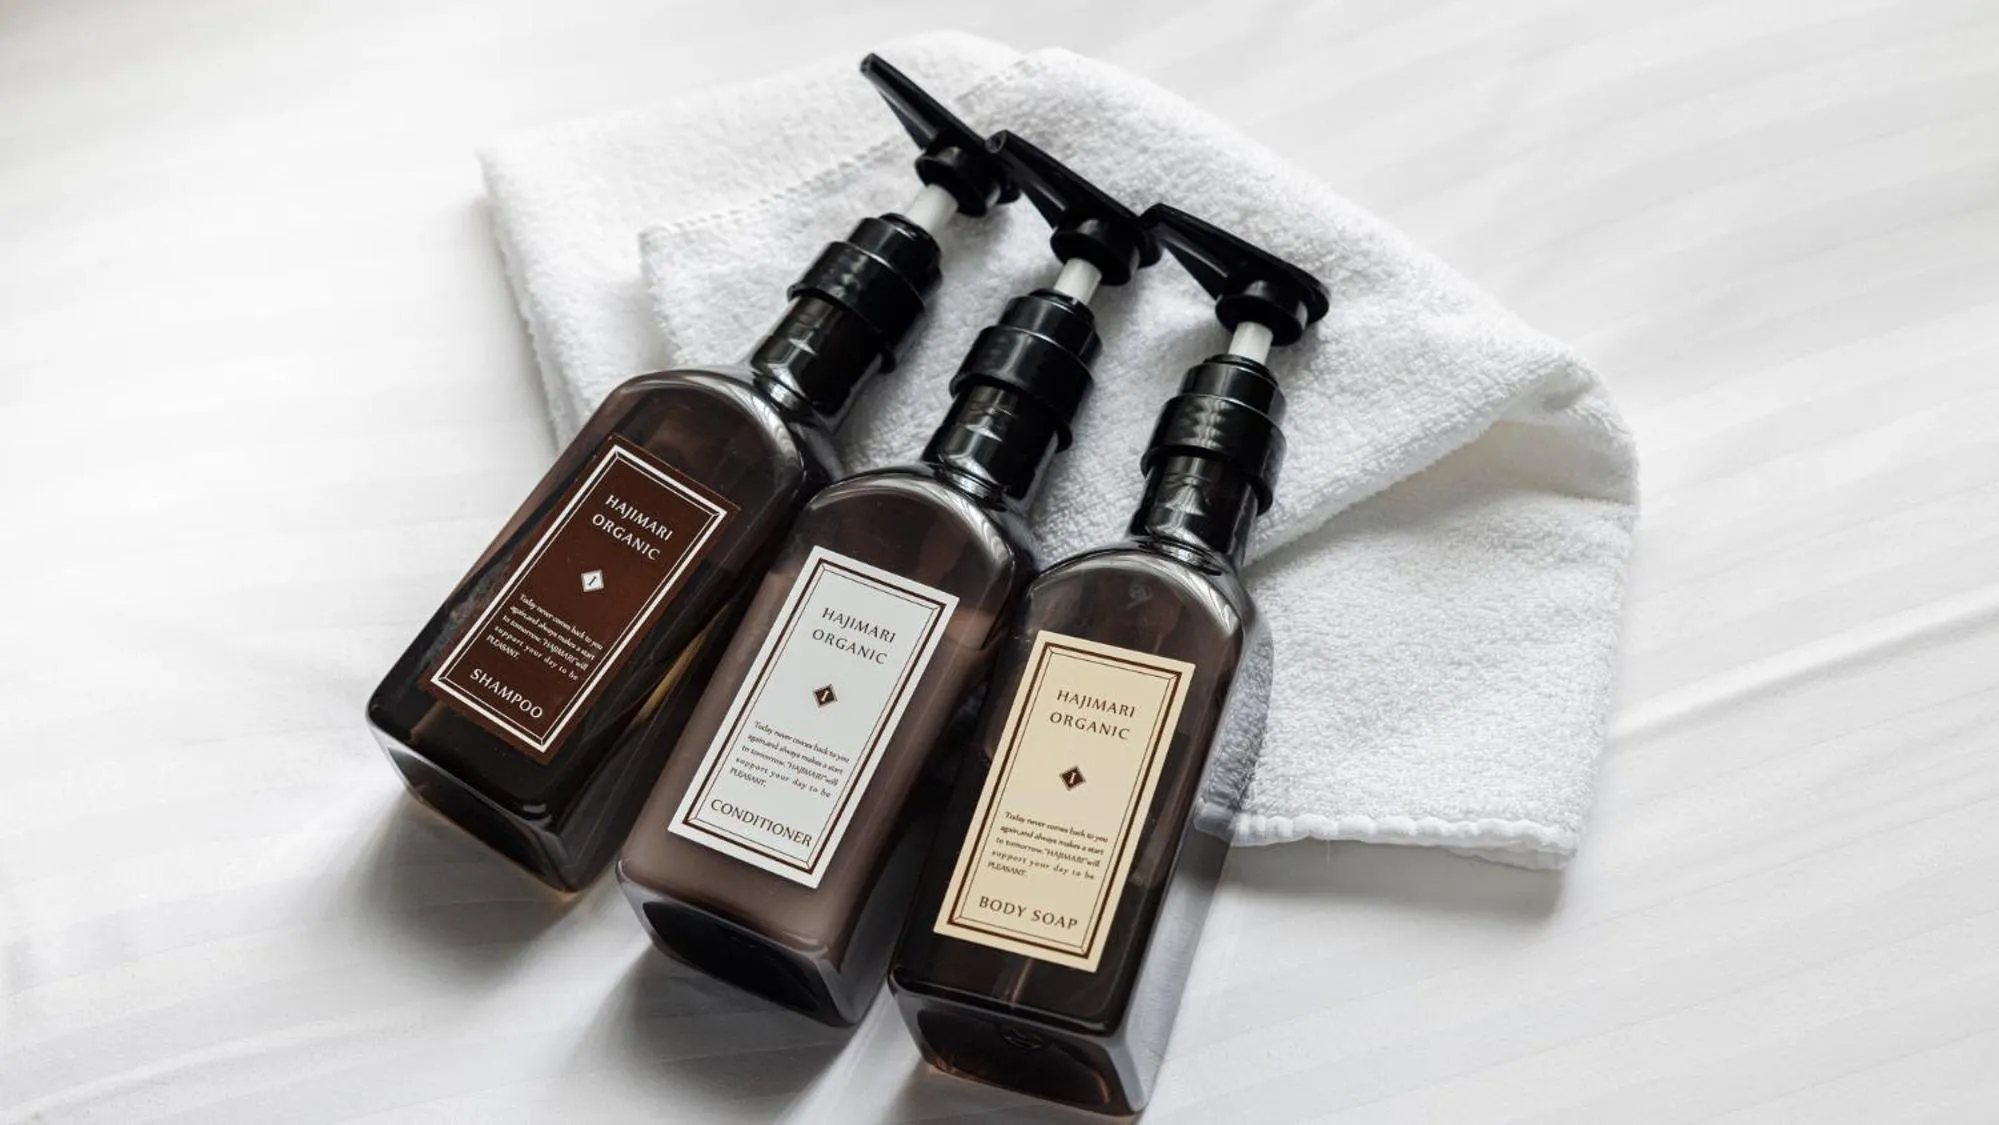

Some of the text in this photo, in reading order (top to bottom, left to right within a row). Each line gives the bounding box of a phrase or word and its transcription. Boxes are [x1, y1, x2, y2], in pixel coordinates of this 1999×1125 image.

[604, 494, 673, 541] HAJIMARI
[591, 513, 660, 560] ORGANIC
[519, 593, 536, 610] Today
[536, 606, 554, 619] never
[552, 616, 571, 631] comes
[570, 625, 586, 639] back
[589, 640, 603, 650] you
[821, 607, 896, 643] HAJIMARI
[493, 625, 524, 647] support
[523, 644, 543, 658] your
[543, 655, 558, 669] day
[568, 669, 578, 681] be
[537, 622, 558, 638] always
[556, 634, 576, 649] makes
[580, 649, 595, 661] start
[812, 628, 888, 664] ORGANIC
[469, 668, 543, 718] SHAMPOO
[1056, 689, 1135, 718] HAJIMARI
[754, 720, 773, 736] Today
[773, 730, 793, 740] never
[791, 737, 813, 749] comes
[812, 743, 829, 755] back
[835, 753, 850, 763] you
[1049, 711, 1130, 740] ORGANIC
[735, 757, 768, 774] support
[768, 770, 790, 782] your
[791, 777, 806, 790] day
[819, 788, 831, 798] be
[778, 745, 801, 759] always
[800, 754, 822, 767] makes
[827, 765, 844, 775] start
[710, 798, 812, 847] CONDITIONER
[1005, 810, 1026, 823] Today
[1026, 818, 1046, 827] never
[1046, 824, 1069, 833] comes
[1068, 826, 1086, 837] back
[1093, 835, 1109, 843] you
[1033, 832, 1057, 844] always
[1058, 839, 1081, 850] makes
[1087, 846, 1104, 856] start
[991, 850, 1027, 864] support
[1029, 859, 1050, 869] your
[1052, 863, 1068, 875] day
[1083, 870, 1095, 880] be
[978, 895, 1078, 929] BODY SOAP
